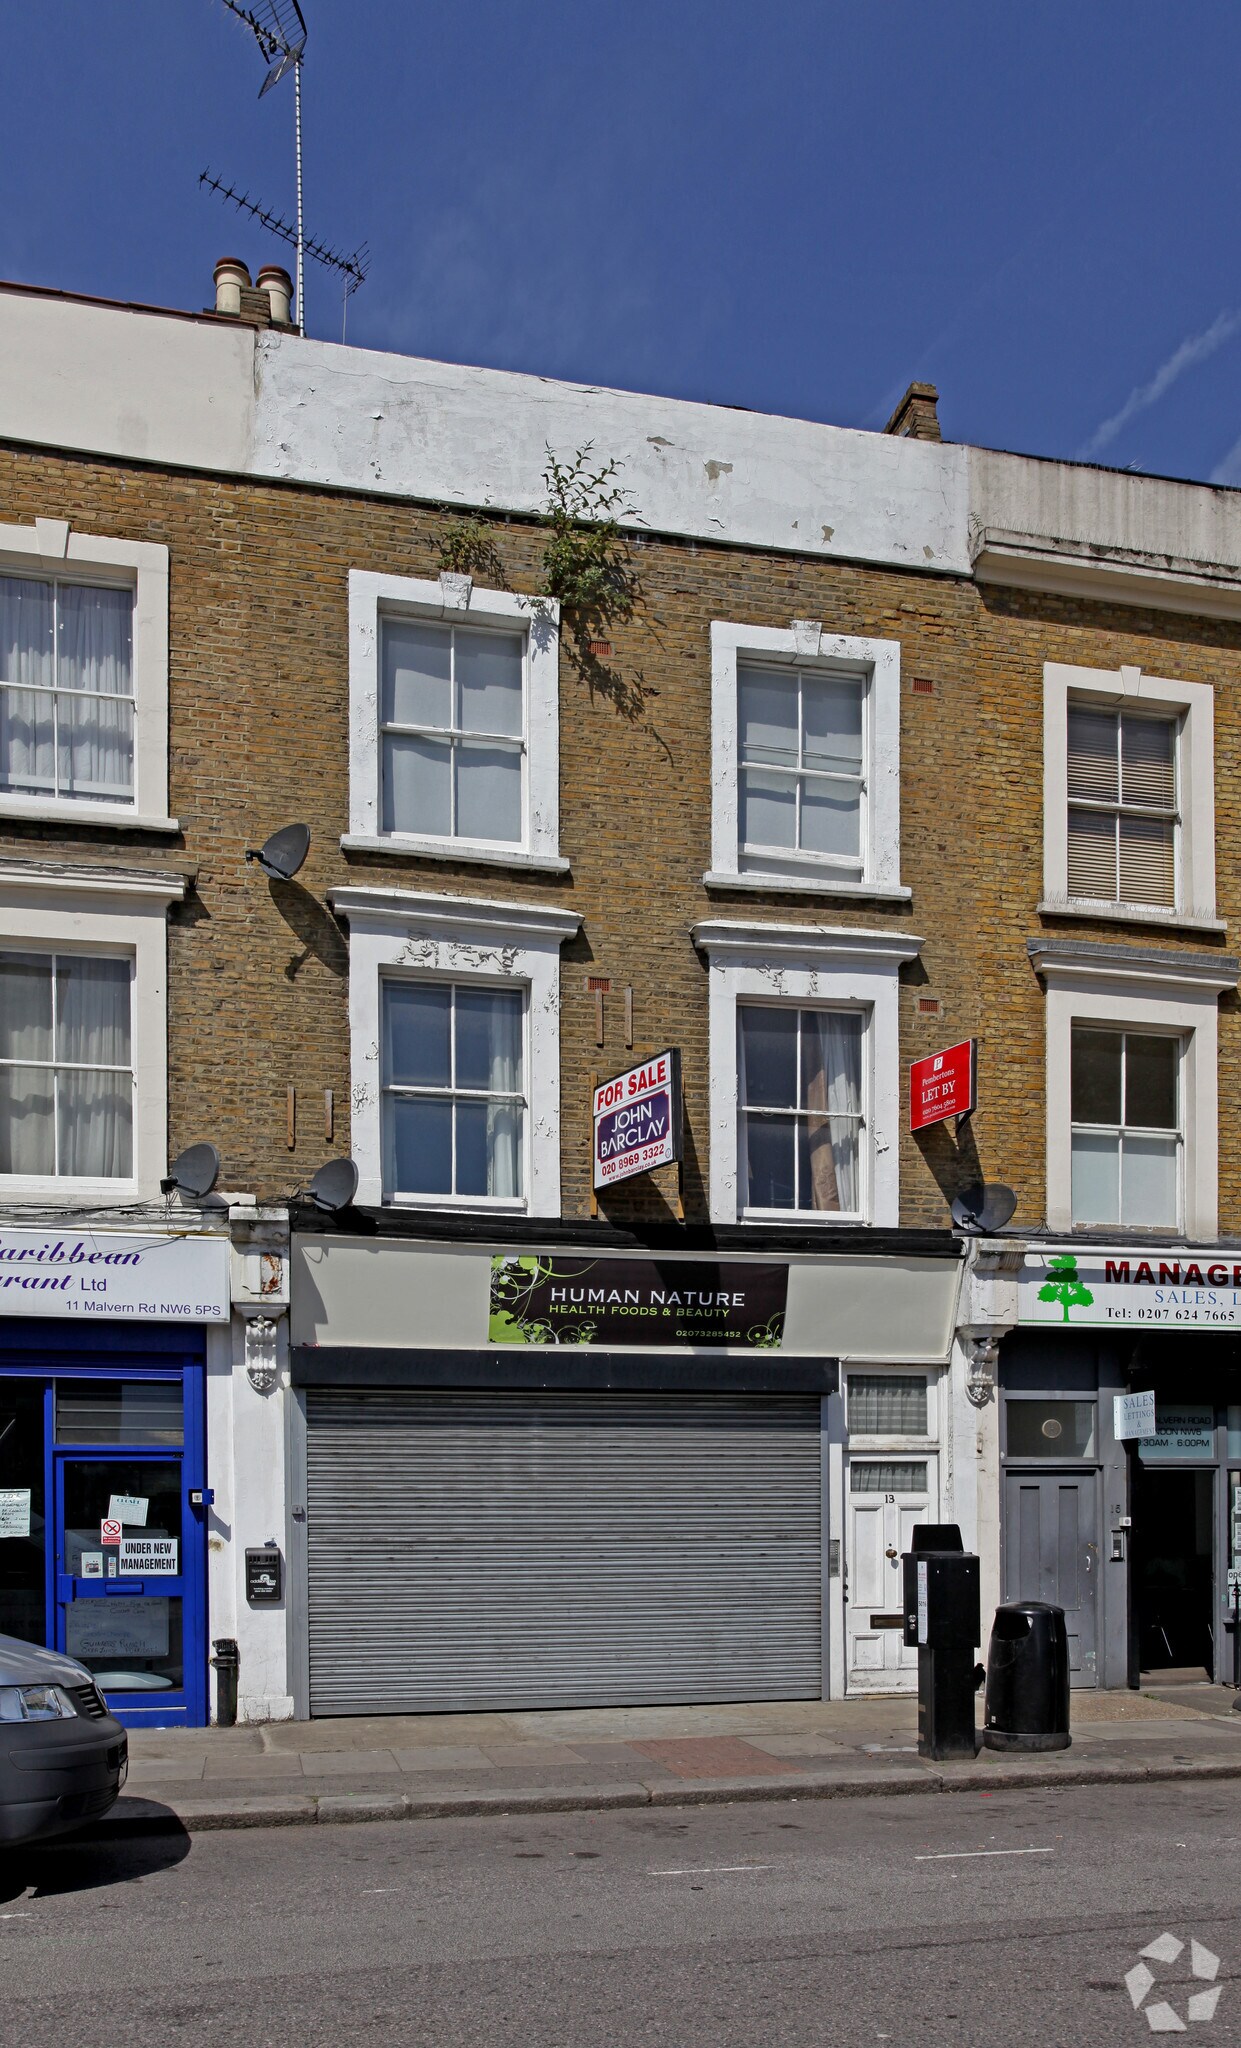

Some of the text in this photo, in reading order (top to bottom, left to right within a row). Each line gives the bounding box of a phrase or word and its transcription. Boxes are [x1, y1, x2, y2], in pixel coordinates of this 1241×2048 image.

[597, 1060, 666, 1111] FOR SALE
[922, 1068, 955, 1087] Pembertons
[921, 1080, 956, 1104] LET BY
[611, 1102, 652, 1133] JOHN
[601, 1117, 665, 1158] BARCLAY
[602, 1143, 665, 1176] 020 8969 3322
[0, 1240, 145, 1267] aribbean
[0, 1273, 108, 1292] rant Ltd
[550, 1287, 745, 1307] HUMAN NATURE
[1154, 1289, 1224, 1307] SALES,
[66, 1300, 222, 1316] 11 Malvern Rd NW6 5PS
[550, 1304, 730, 1319] HEALTH FOODS & BEAUTY
[1105, 1307, 1235, 1322] Tel: 0207 624 7665
[675, 1329, 742, 1339] 02073285452
[1124, 1393, 1154, 1410] SALES
[1124, 1408, 1155, 1421] LETTINGS
[1188, 1416, 1211, 1425] ROAD
[1124, 1427, 1155, 1437] MANAGEMENT
[1136, 1420, 1142, 1428] &
[1180, 1428, 1202, 1436] NW6
[884, 1494, 895, 1504] 13
[125, 1543, 172, 1554] UNDER NEW
[121, 1558, 176, 1570] MANAGEMENT
